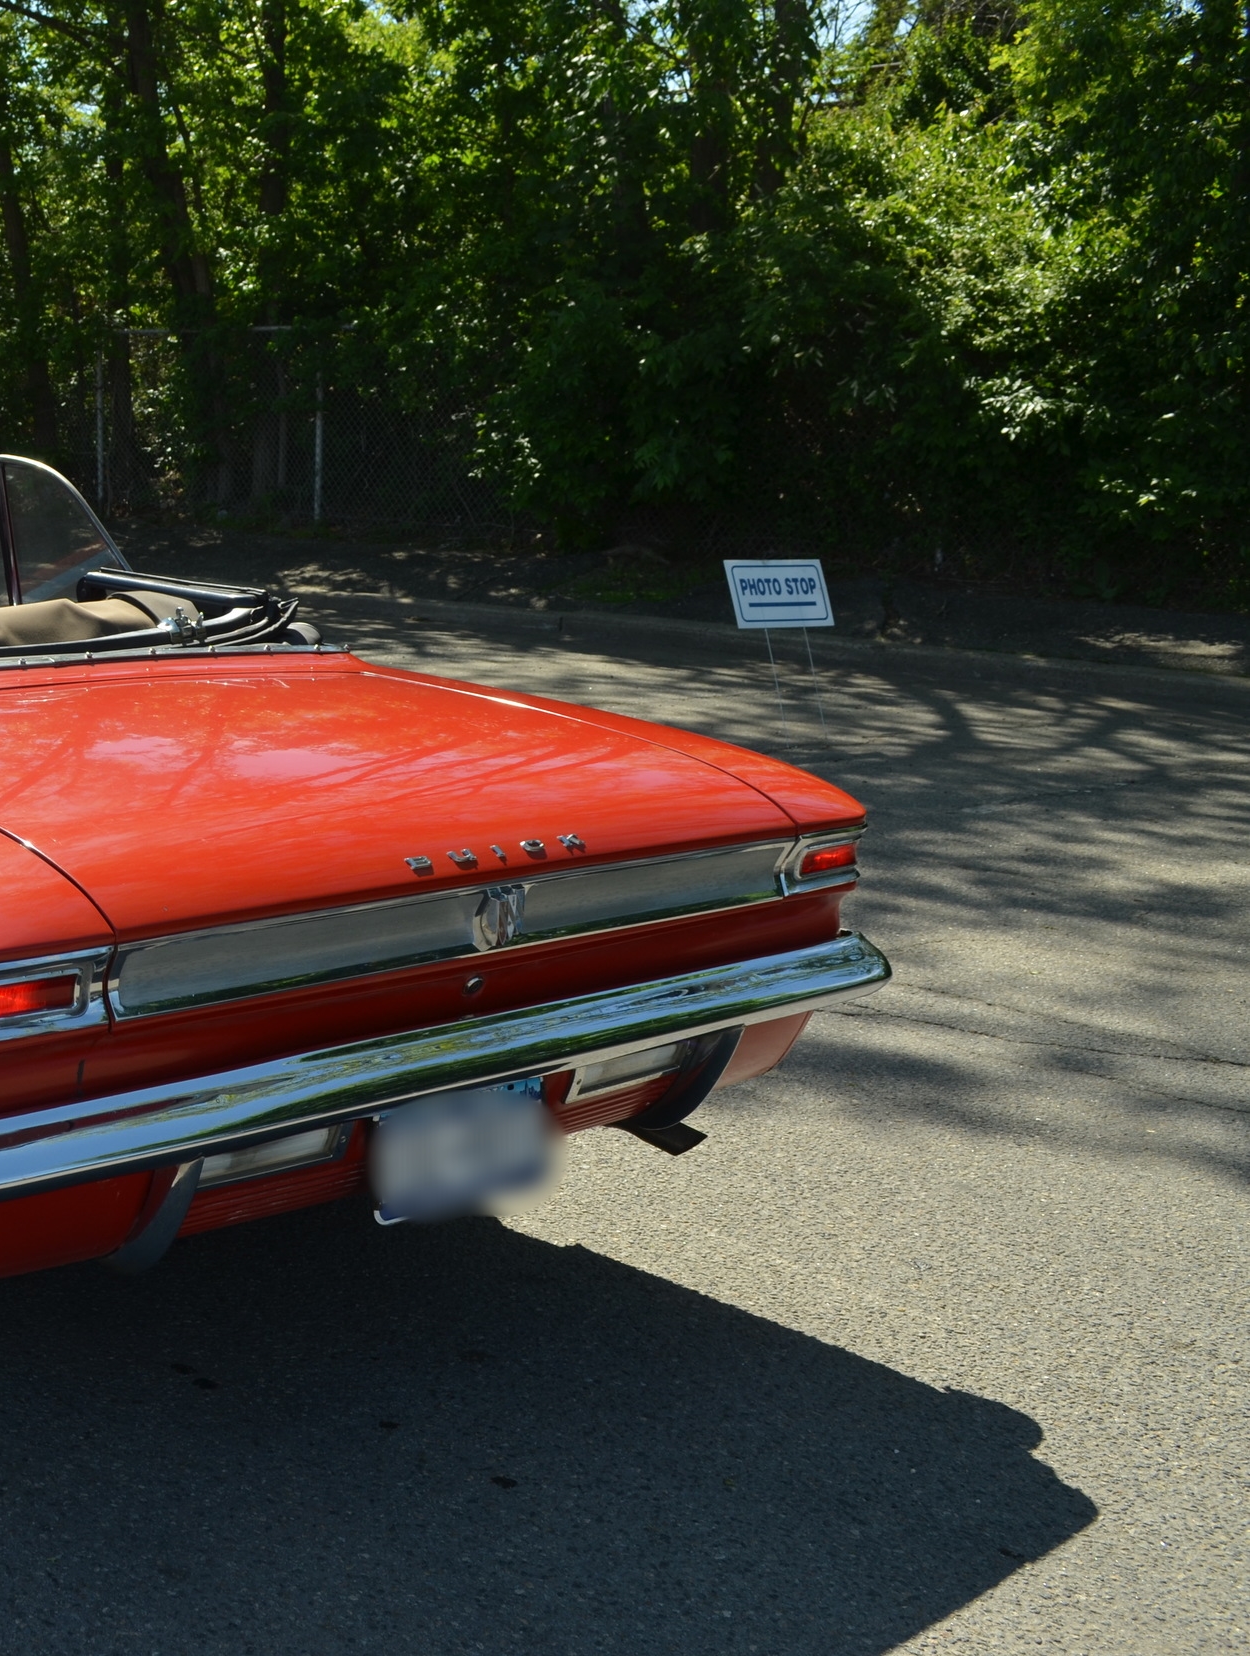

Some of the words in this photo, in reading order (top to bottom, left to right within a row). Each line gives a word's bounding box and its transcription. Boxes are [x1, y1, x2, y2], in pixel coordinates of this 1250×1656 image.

[739, 578, 782, 596] PHOTO
[785, 577, 817, 595] STOP
[404, 834, 586, 869] BUICK
